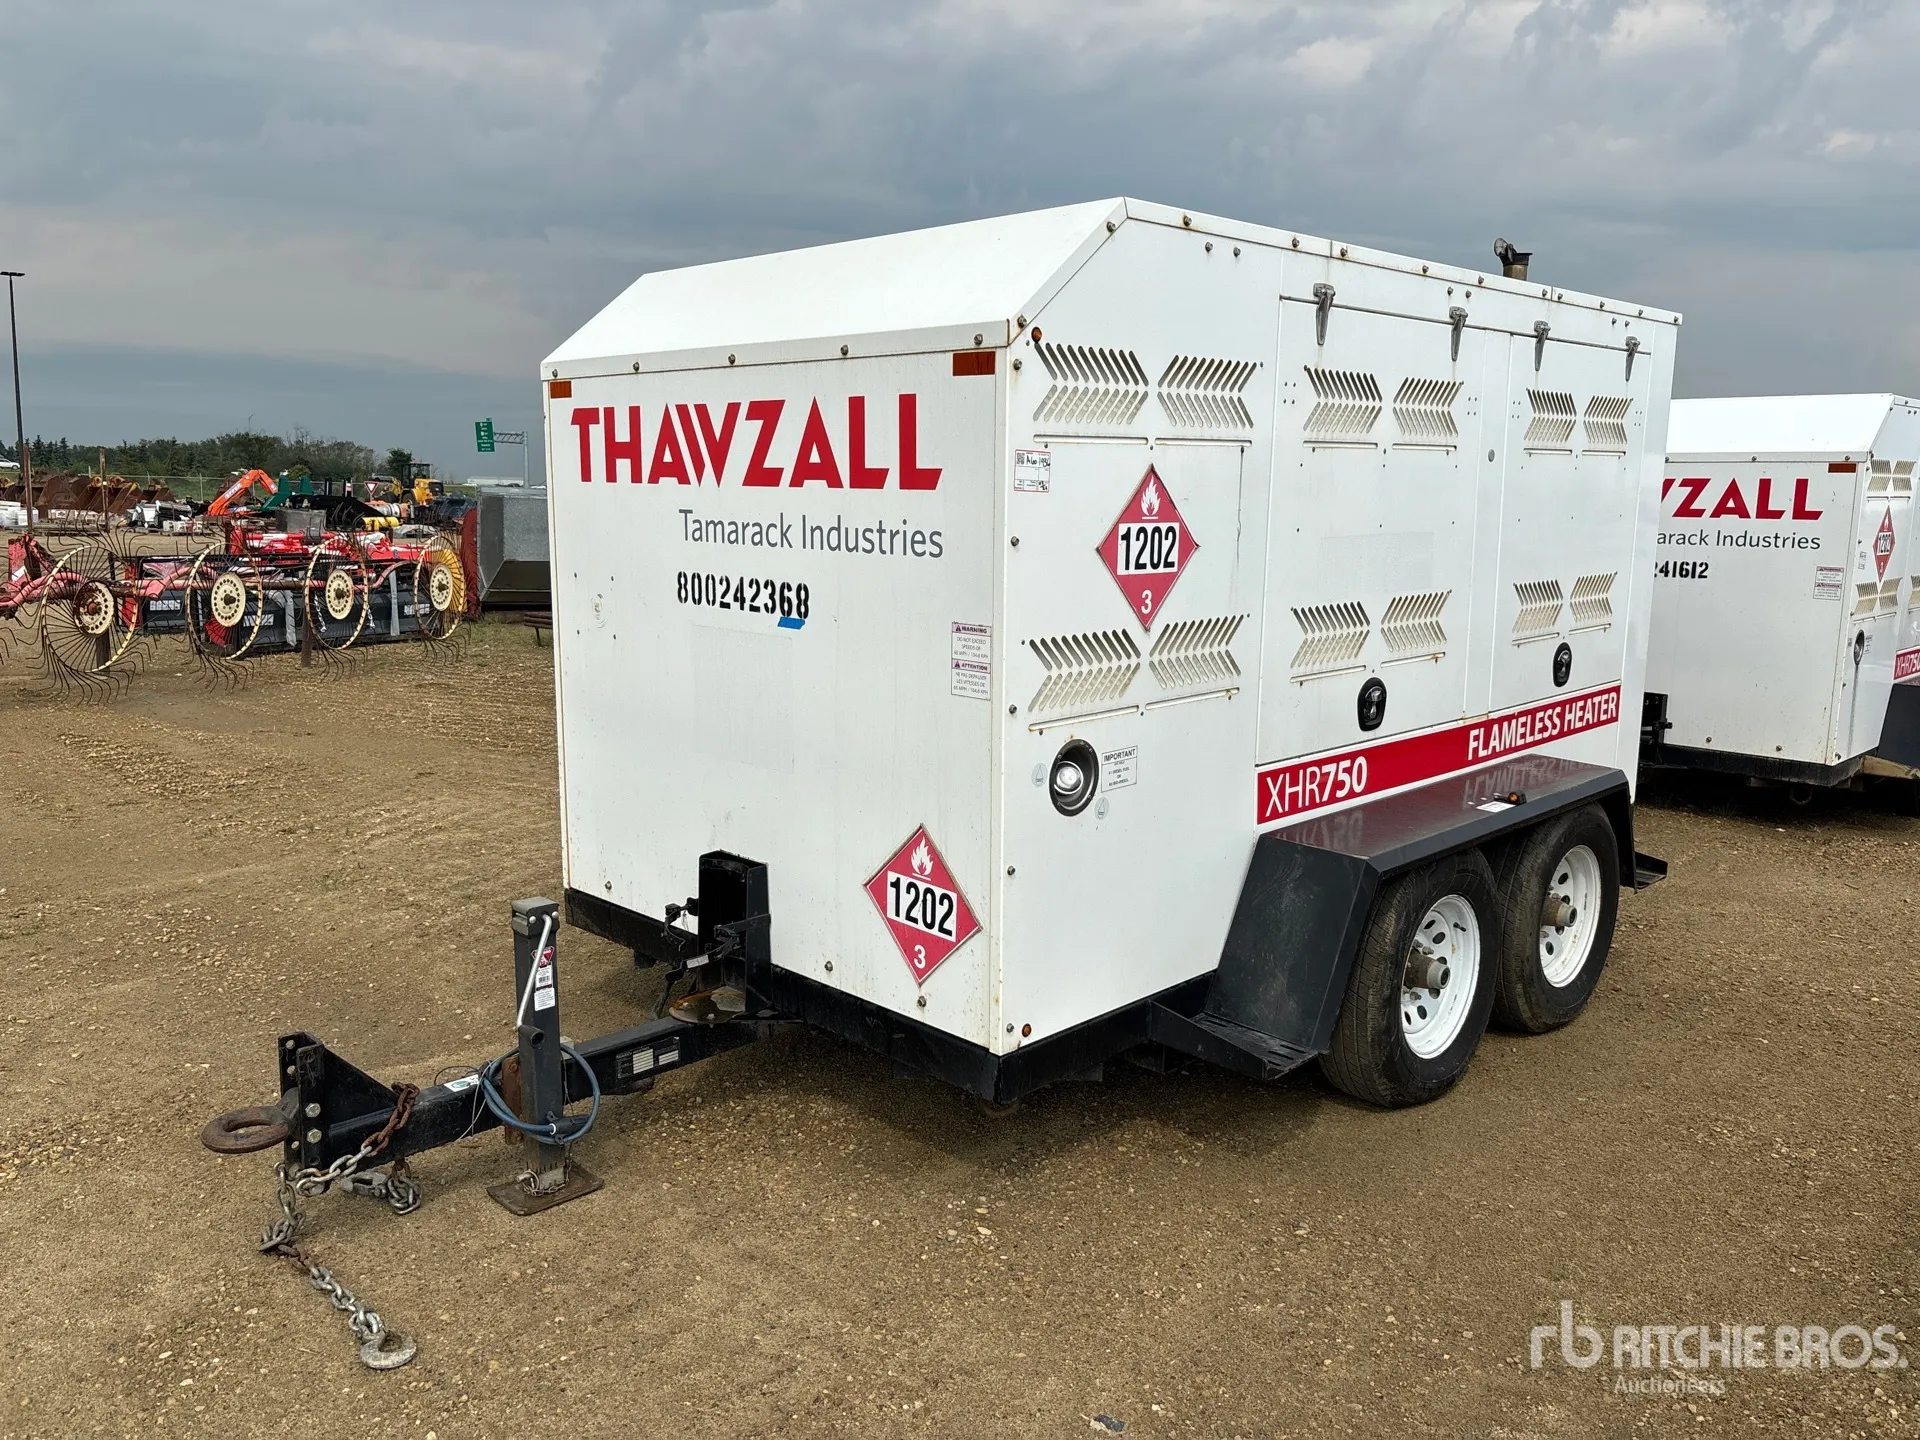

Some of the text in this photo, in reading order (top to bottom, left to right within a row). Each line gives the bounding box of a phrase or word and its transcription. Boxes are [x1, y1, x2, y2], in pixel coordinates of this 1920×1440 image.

[571, 393, 943, 490] THAWZALL
[679, 508, 943, 558] Tamarack Industries
[1120, 525, 1177, 572] 1202
[1716, 529, 1821, 550] Industries
[677, 571, 811, 620] 800242368
[1141, 589, 1153, 615] 3
[1468, 691, 1617, 761] FLAMELESS HEATER
[1104, 748, 1136, 763] IMPORTANT
[1265, 756, 1368, 818] XHR750
[890, 877, 954, 937] 1202
[914, 944, 926, 969] 3
